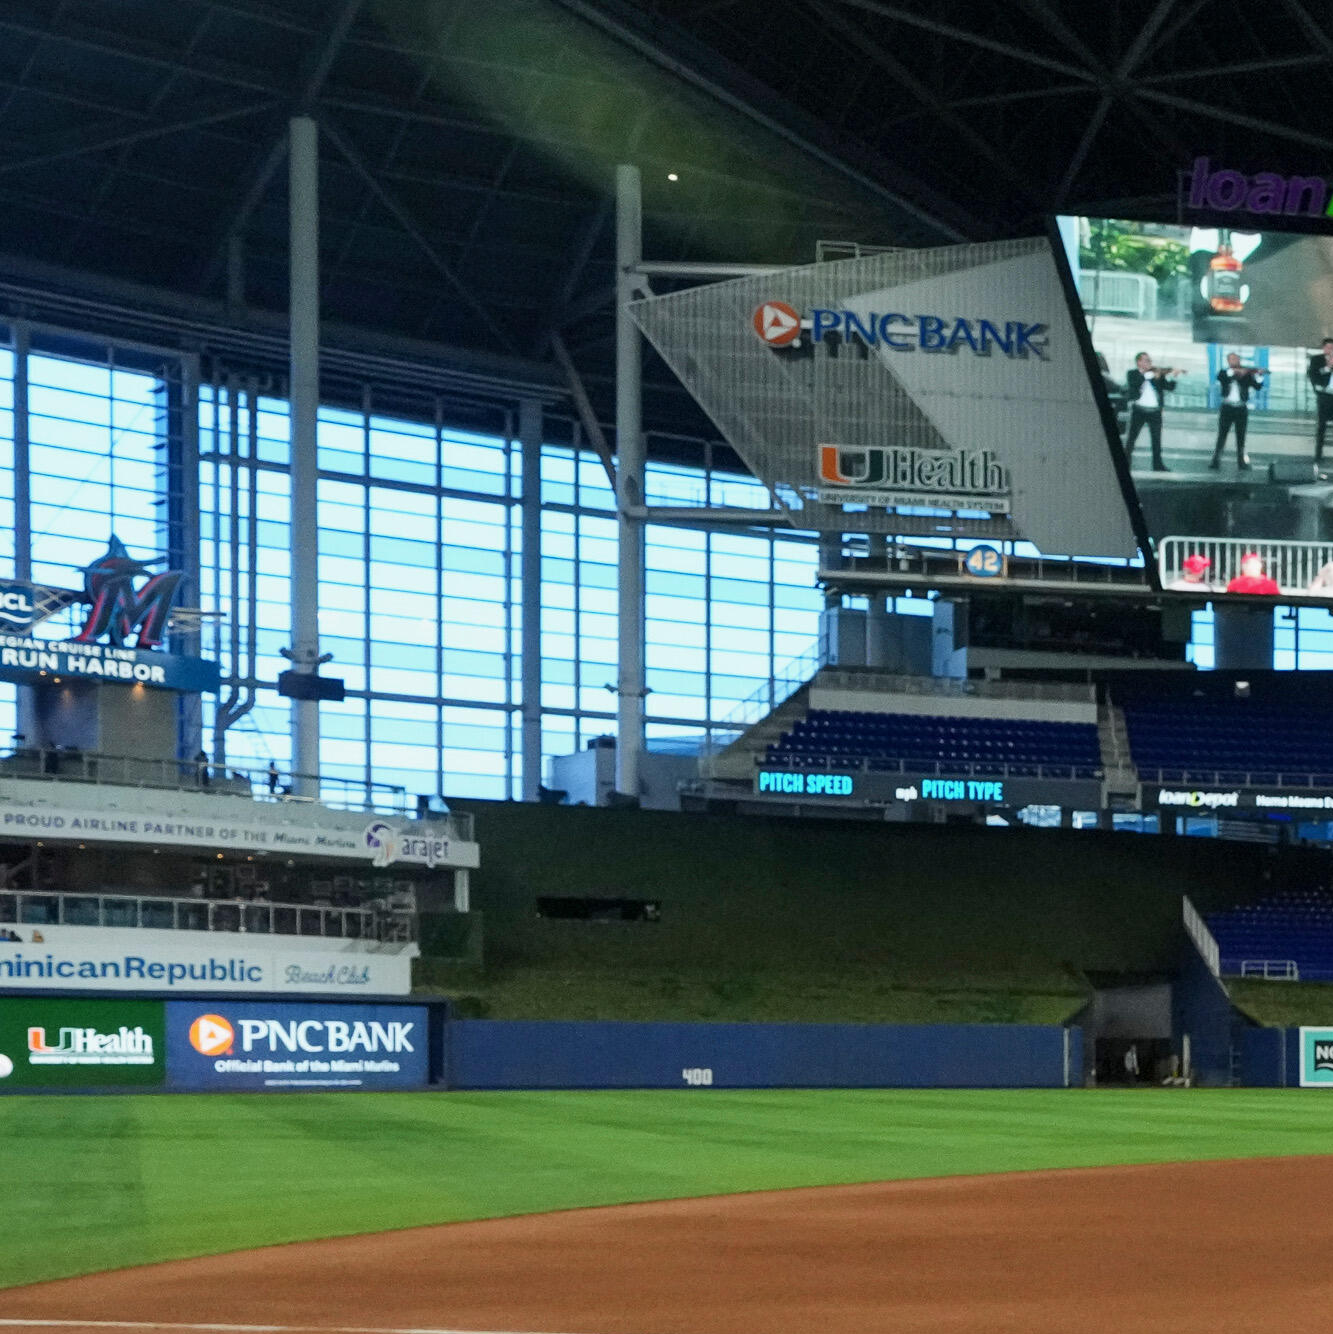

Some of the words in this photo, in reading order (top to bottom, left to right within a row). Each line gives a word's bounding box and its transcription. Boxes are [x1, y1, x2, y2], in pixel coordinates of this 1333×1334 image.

[969, 550, 998, 571] 42
[2, 648, 59, 671] RUN
[67, 655, 166, 683] HARBOR
[759, 771, 804, 793] PITCH
[806, 774, 853, 795] SPEED
[921, 779, 966, 799] PITCH
[967, 781, 1003, 801] TYPE
[4, 812, 66, 829] PROUD
[71, 817, 138, 834] AIRLINE
[143, 821, 215, 839] PARTNER
[284, 963, 337, 985] Beach
[337, 964, 371, 986] Club
[214, 1059, 263, 1073] Official
